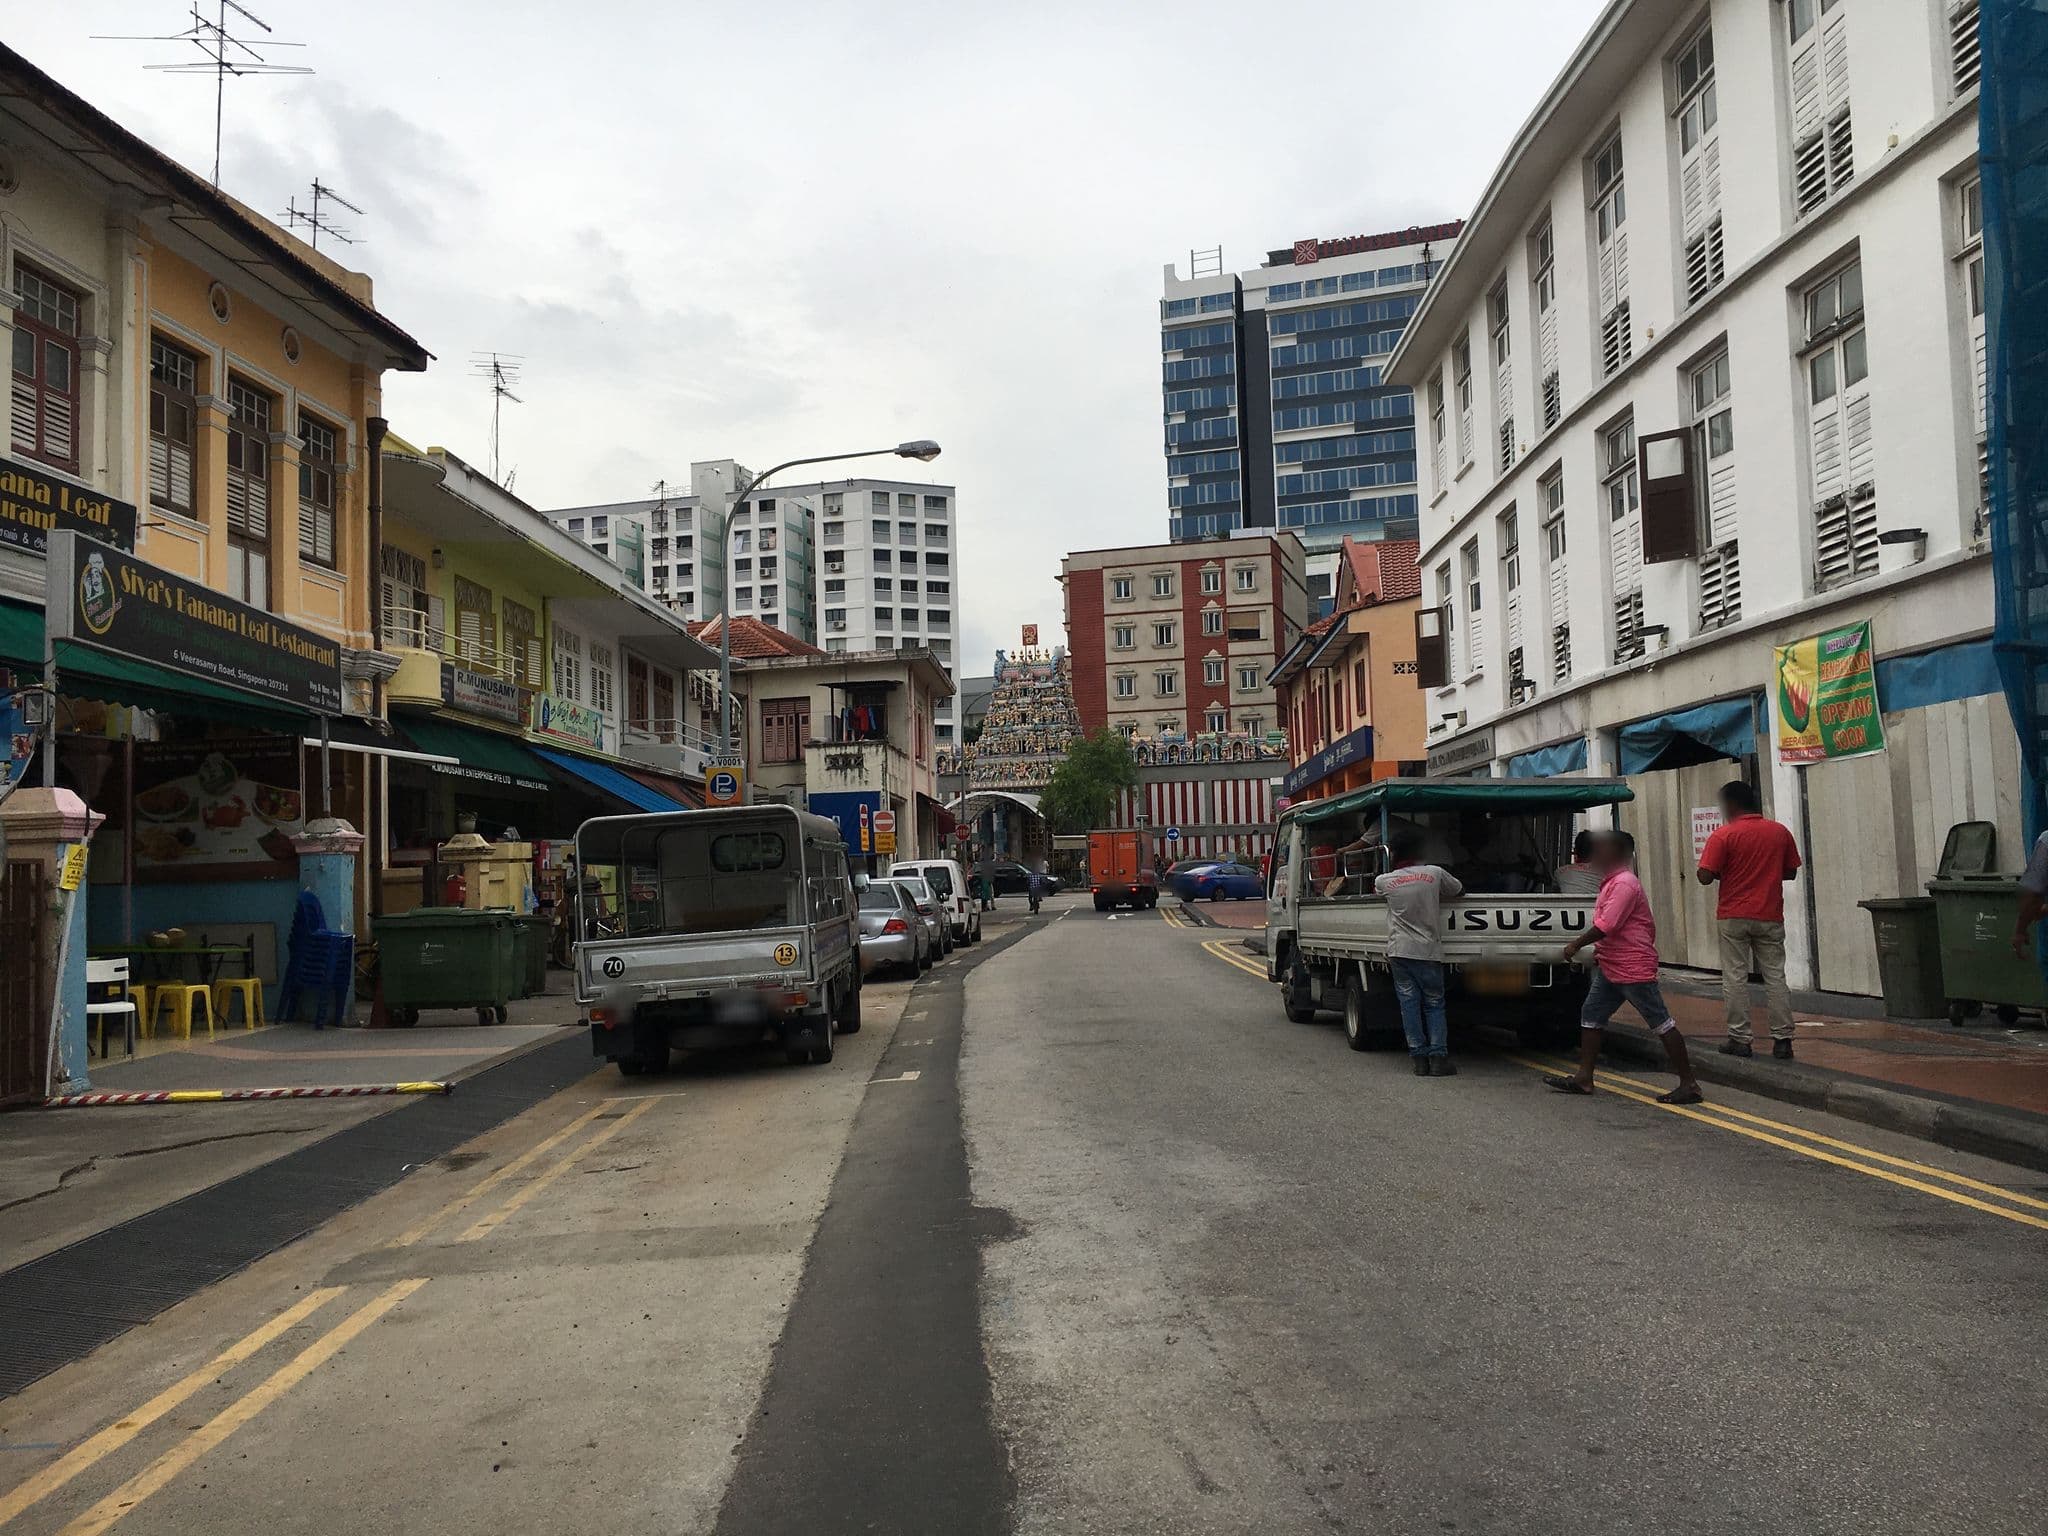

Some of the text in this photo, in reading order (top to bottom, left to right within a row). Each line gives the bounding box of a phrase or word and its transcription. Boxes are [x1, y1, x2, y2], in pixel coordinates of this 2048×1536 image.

[60, 486, 111, 525] Leaf
[121, 565, 172, 609] Siva's
[176, 587, 237, 632] Banana
[241, 613, 269, 644] Leaf
[272, 624, 336, 668] Restaurant
[173, 649, 289, 692] 6 Veerasamy Road, Singapore 207314
[457, 671, 516, 698] R.MUNUSAMY
[1821, 696, 1872, 725] OPENING
[1833, 726, 1867, 751] SOON
[718, 758, 741, 766] V0001
[1448, 910, 1586, 931] ISUZU
[778, 946, 793, 957] 13
[606, 960, 622, 972] 70
